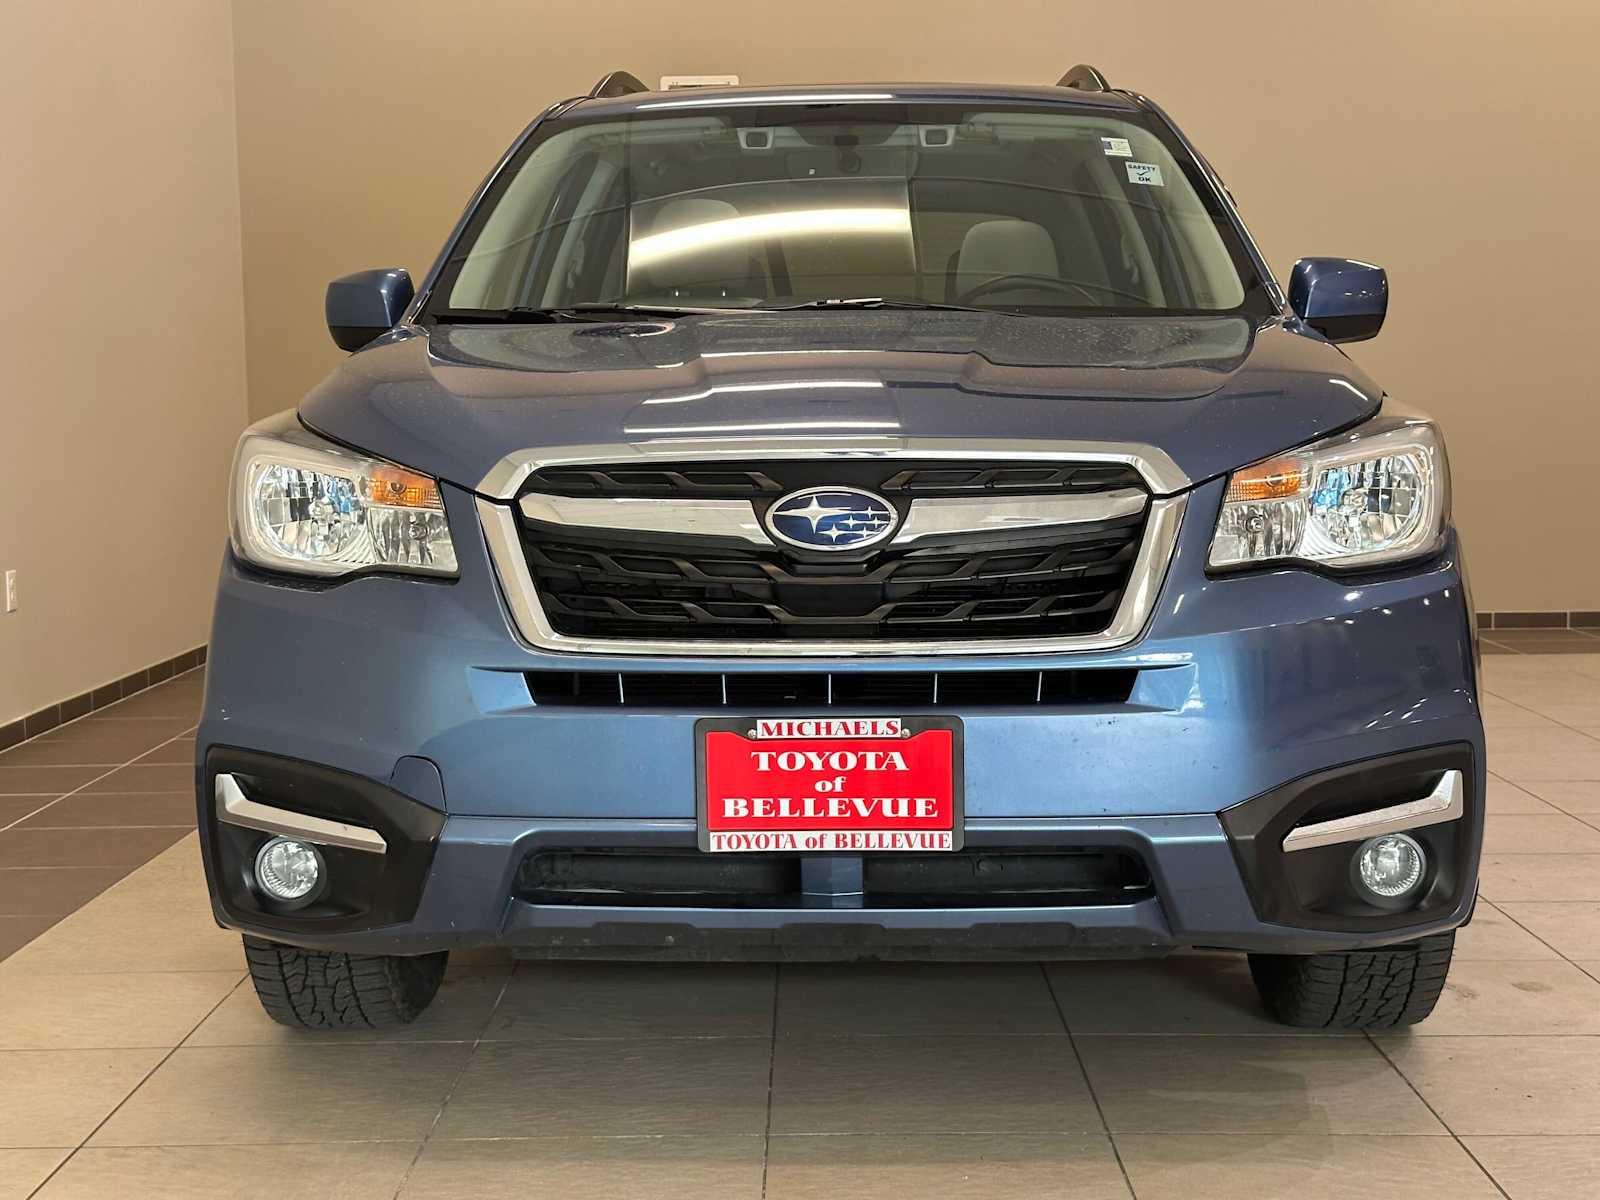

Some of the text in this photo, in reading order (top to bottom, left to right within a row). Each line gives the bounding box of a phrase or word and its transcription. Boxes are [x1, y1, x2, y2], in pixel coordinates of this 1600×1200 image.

[761, 720, 899, 736] MICHAELS
[751, 751, 909, 771] TOYOTA
[814, 776, 847, 792] of
[721, 797, 938, 818] BELLEVUE
[712, 832, 951, 849] TOYOTA of BELLEVUE
